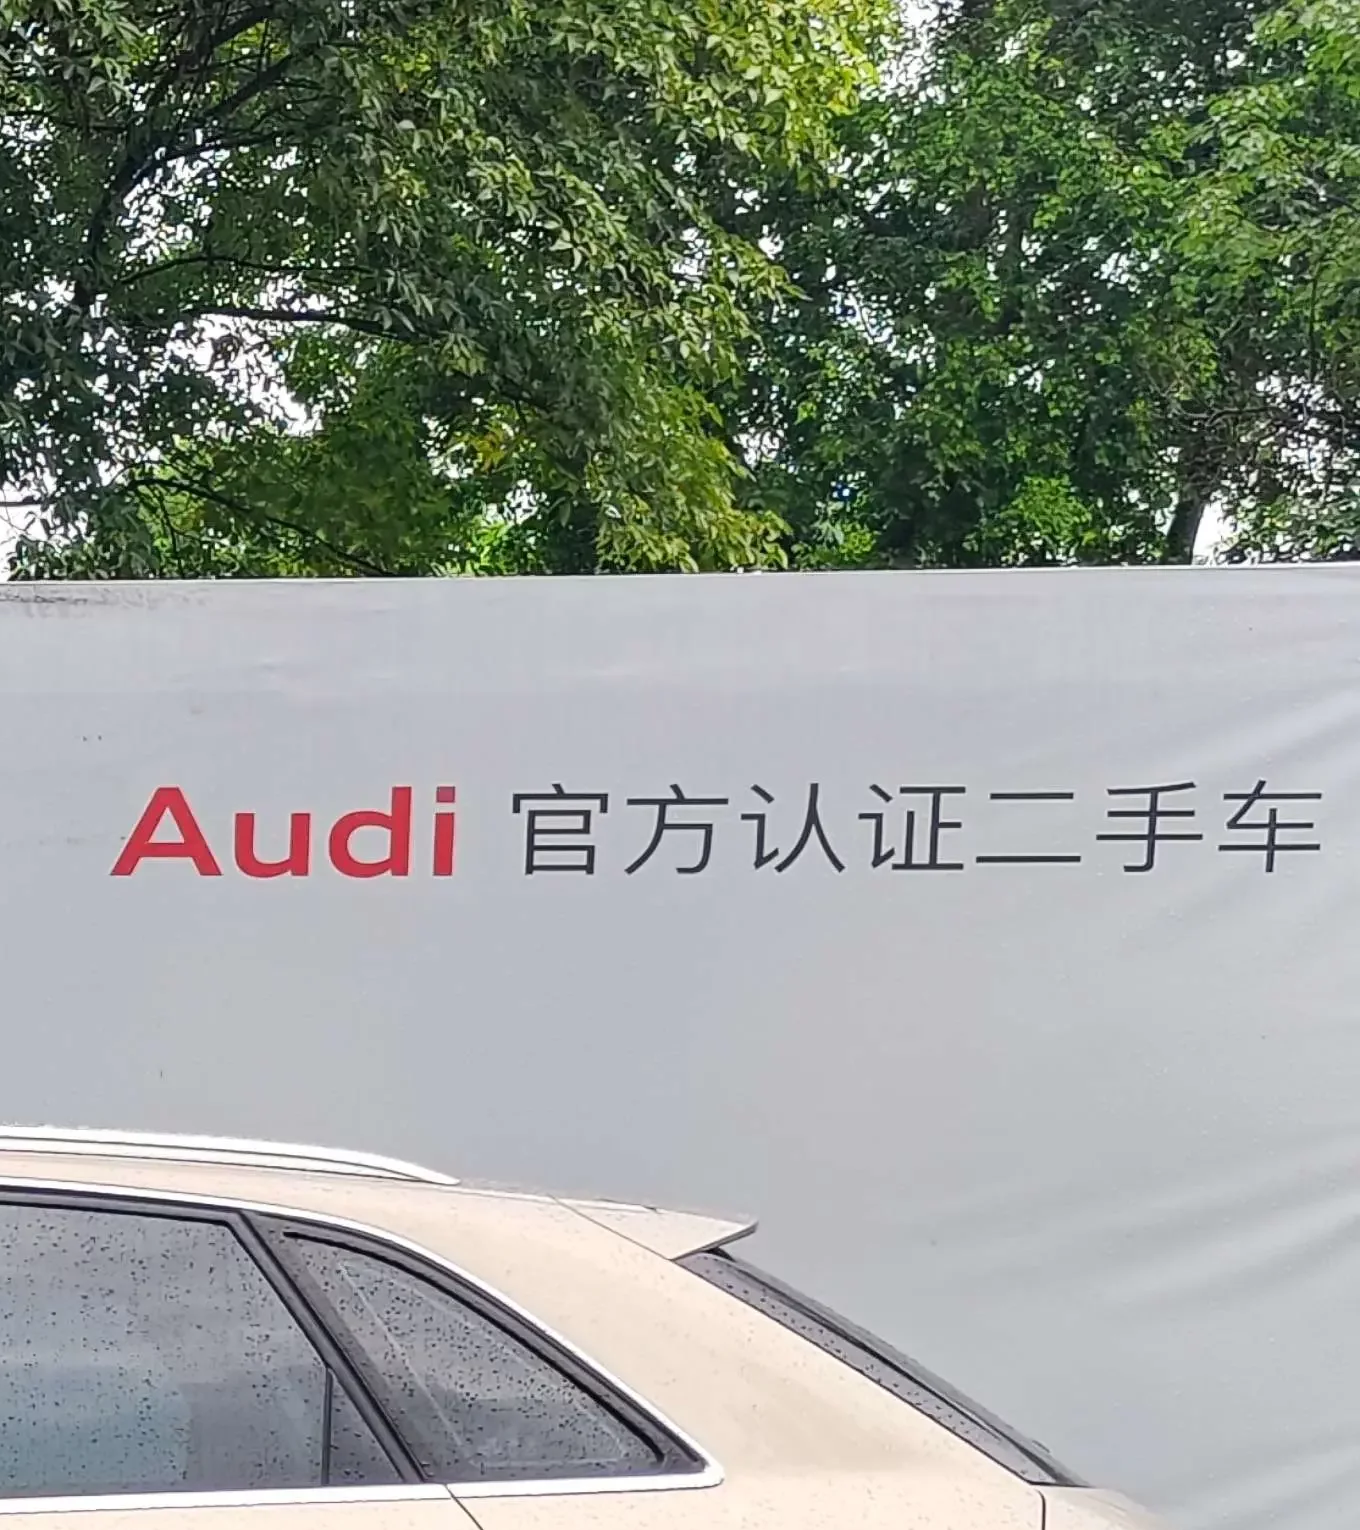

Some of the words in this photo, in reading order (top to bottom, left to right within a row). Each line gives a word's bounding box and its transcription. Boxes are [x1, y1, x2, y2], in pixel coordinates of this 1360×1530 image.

[109, 785, 457, 878] Audi
[511, 780, 1322, 875] 官方认证二手车
